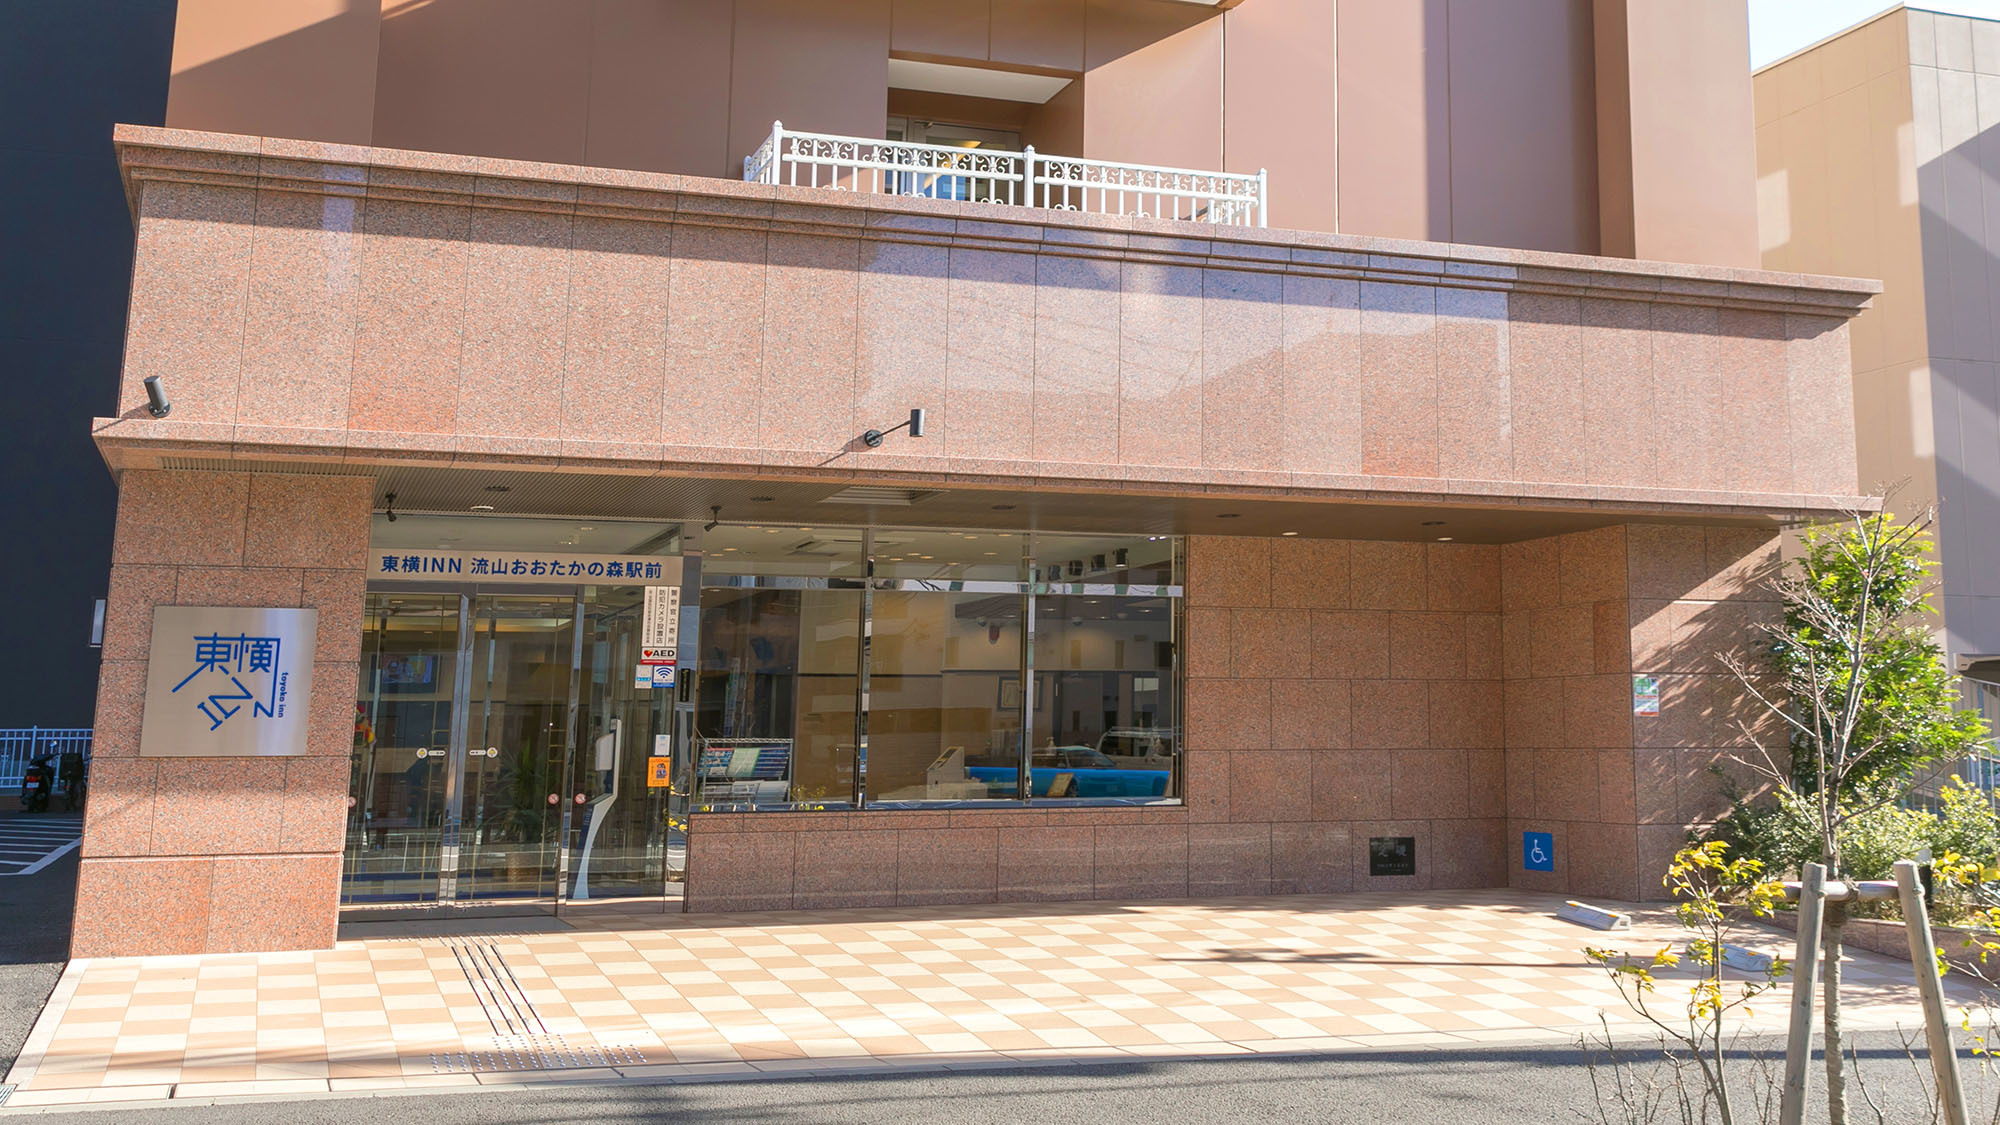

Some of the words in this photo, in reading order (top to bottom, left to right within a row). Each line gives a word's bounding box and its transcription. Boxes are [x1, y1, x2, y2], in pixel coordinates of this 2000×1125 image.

[380, 555, 463, 574] 東横INN
[470, 557, 663, 579] 流山おおたかの森駅前
[653, 649, 675, 657] AED
[279, 672, 288, 702] toyoko
[278, 704, 287, 718] inn
